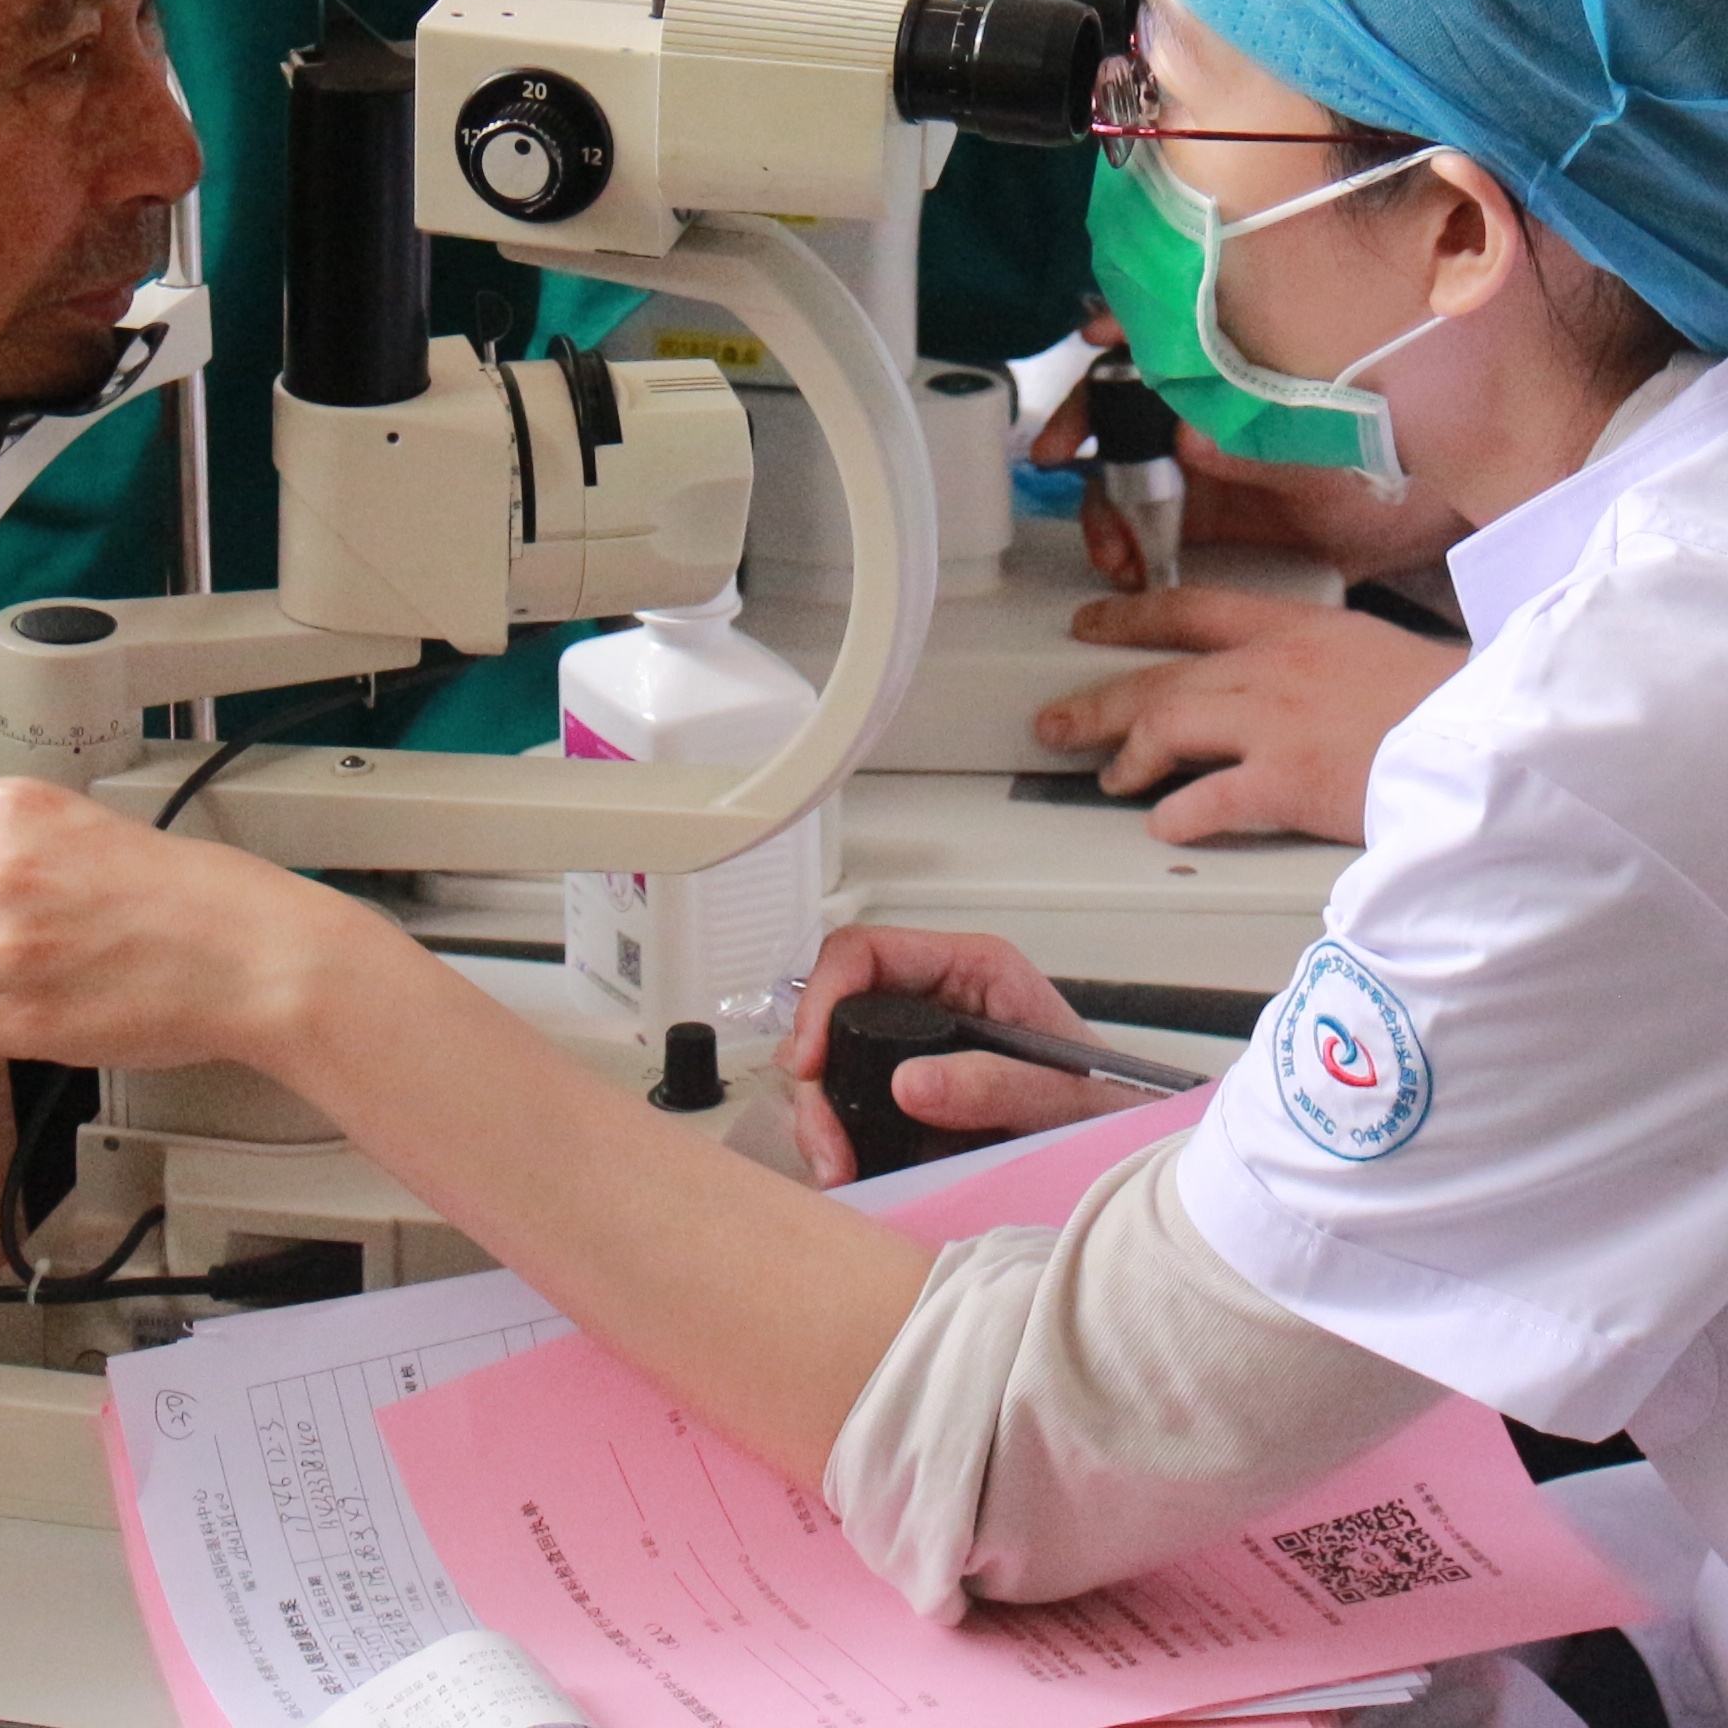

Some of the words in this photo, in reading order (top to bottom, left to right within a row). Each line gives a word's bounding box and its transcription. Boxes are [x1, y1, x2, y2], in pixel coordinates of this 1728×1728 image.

[522, 80, 547, 100] 20
[581, 147, 602, 166] 12
[29, 725, 44, 737] 60
[69, 726, 84, 738] 30
[308, 1574, 336, 1618] 出生日期
[336, 1569, 365, 1613] 联系电话
[278, 1597, 345, 1695] 成年人眼健康档案
